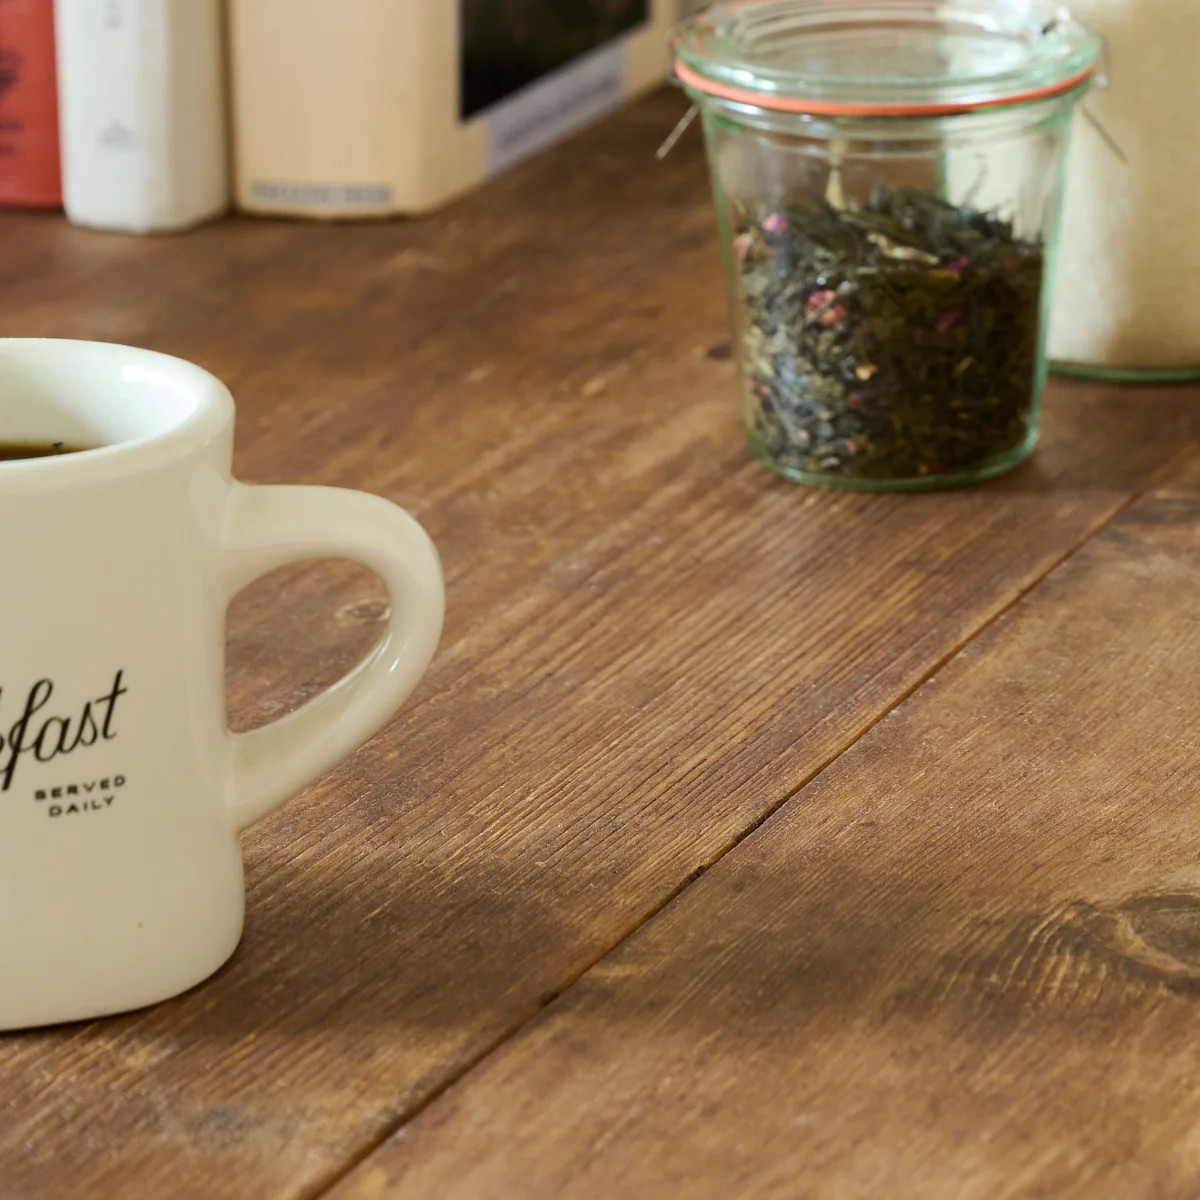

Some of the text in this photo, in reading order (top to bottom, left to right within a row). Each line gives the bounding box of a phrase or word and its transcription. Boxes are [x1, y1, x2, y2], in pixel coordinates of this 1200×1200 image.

[0, 668, 128, 792] fast
[34, 774, 127, 801] SERVED
[48, 795, 115, 818] DAILY
